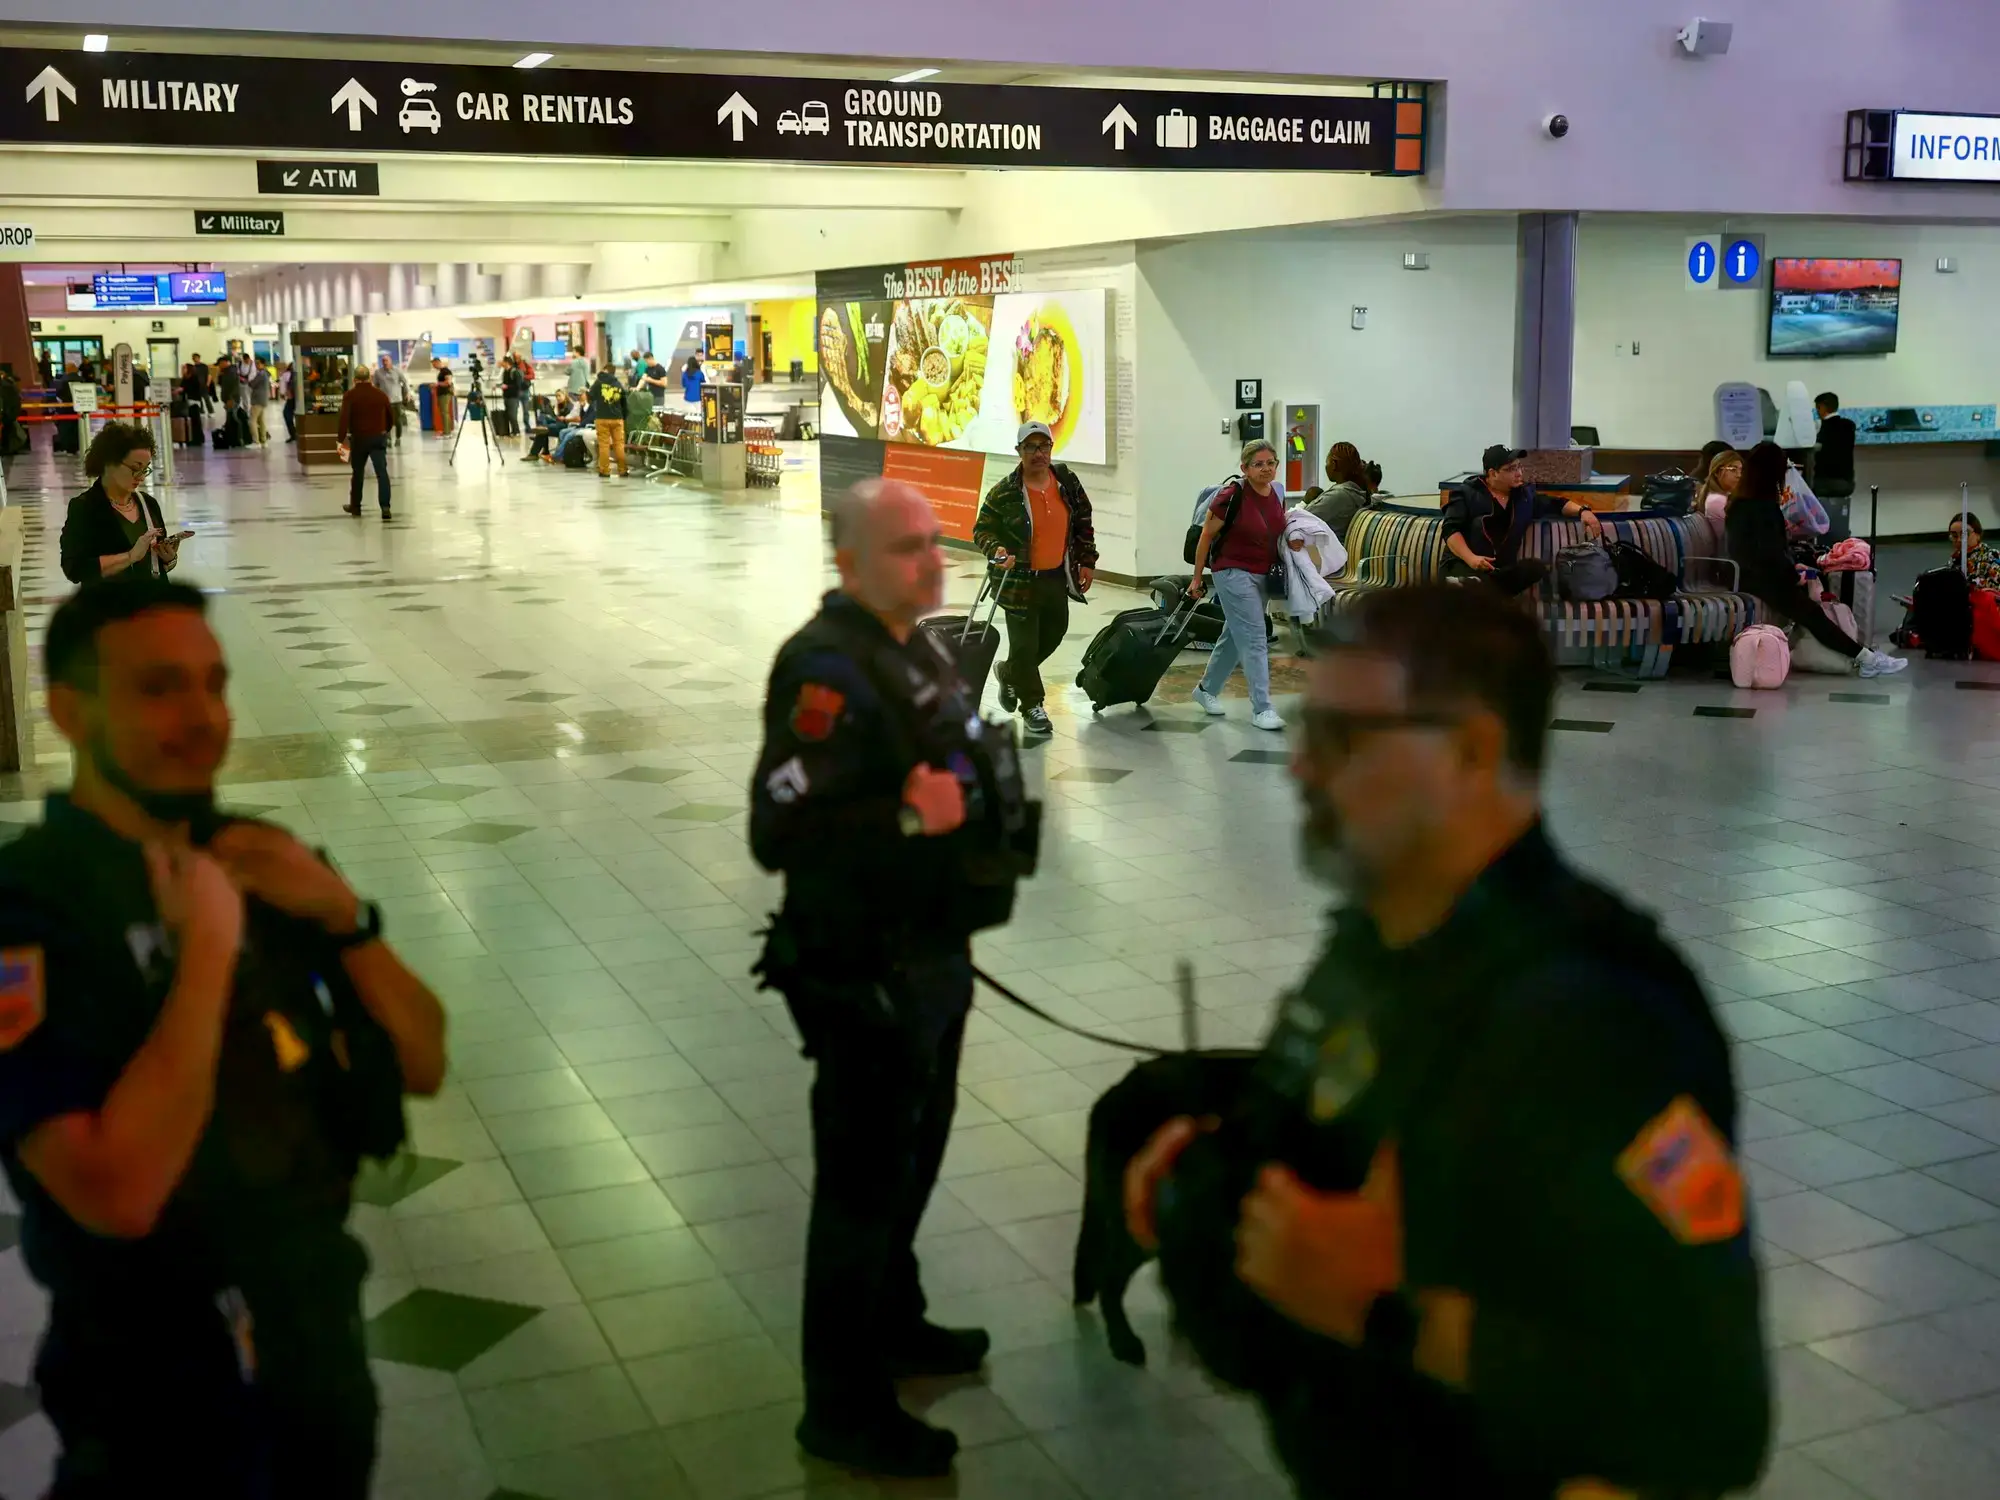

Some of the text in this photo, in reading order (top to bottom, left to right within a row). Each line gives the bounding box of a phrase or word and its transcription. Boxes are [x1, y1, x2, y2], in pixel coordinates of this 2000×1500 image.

[102, 78, 240, 113] MILITARY
[456, 91, 634, 125] CAR RENTALS
[844, 88, 942, 117] GROUND
[843, 120, 1041, 151] TRANSPORTATION
[1208, 115, 1371, 145] BAGGAGE CLAIM
[308, 168, 358, 188] ATM
[220, 215, 281, 234] Military
[181, 279, 211, 293] 7:21
[883, 271, 904, 299] The
[904, 265, 943, 298] BEST
[943, 268, 958, 298] of
[958, 270, 979, 296] the
[979, 257, 1025, 295] BEST
[689, 325, 699, 338] 2
